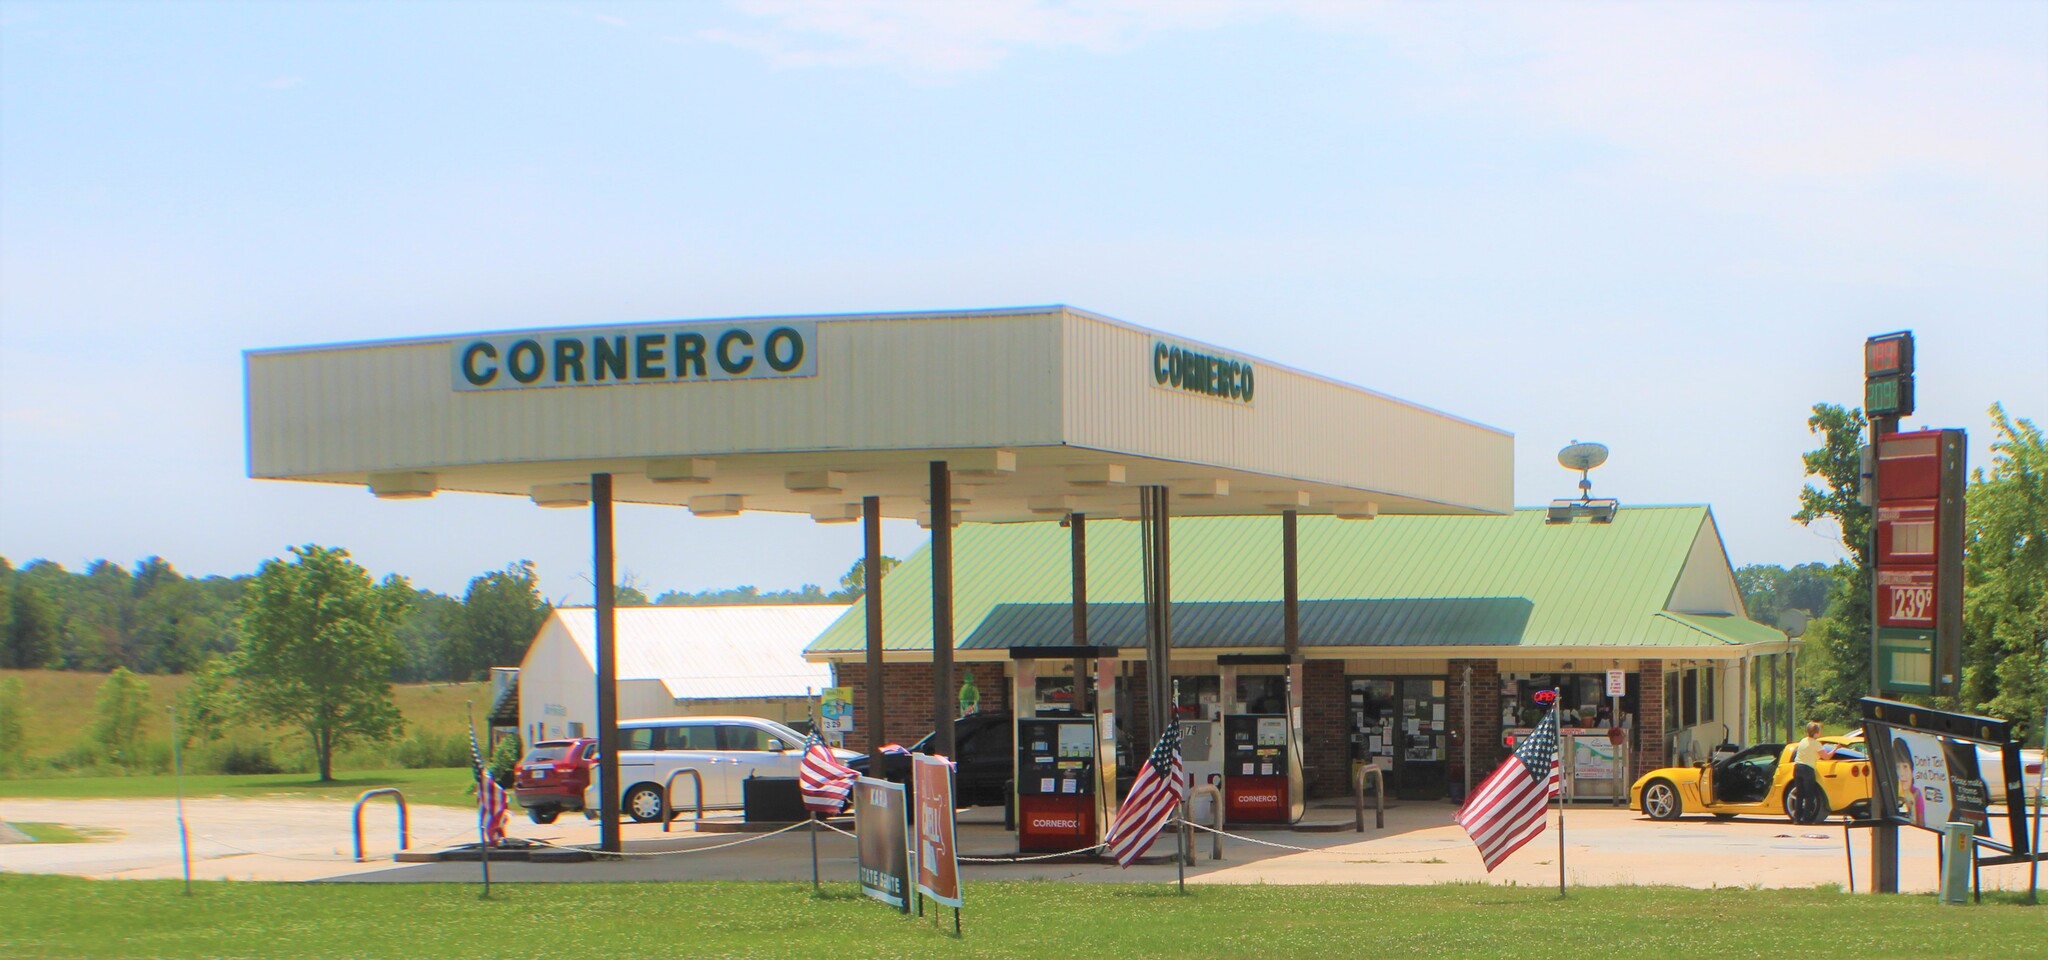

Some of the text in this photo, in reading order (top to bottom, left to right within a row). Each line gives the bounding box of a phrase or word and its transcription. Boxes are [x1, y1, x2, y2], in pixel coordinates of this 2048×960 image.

[461, 326, 804, 386] CORNERCO
[1154, 342, 1255, 403] CORNERCO
[1533, 690, 1557, 702] OPE
[1915, 771, 1927, 780] and
[1239, 794, 1278, 803] CORNERCO
